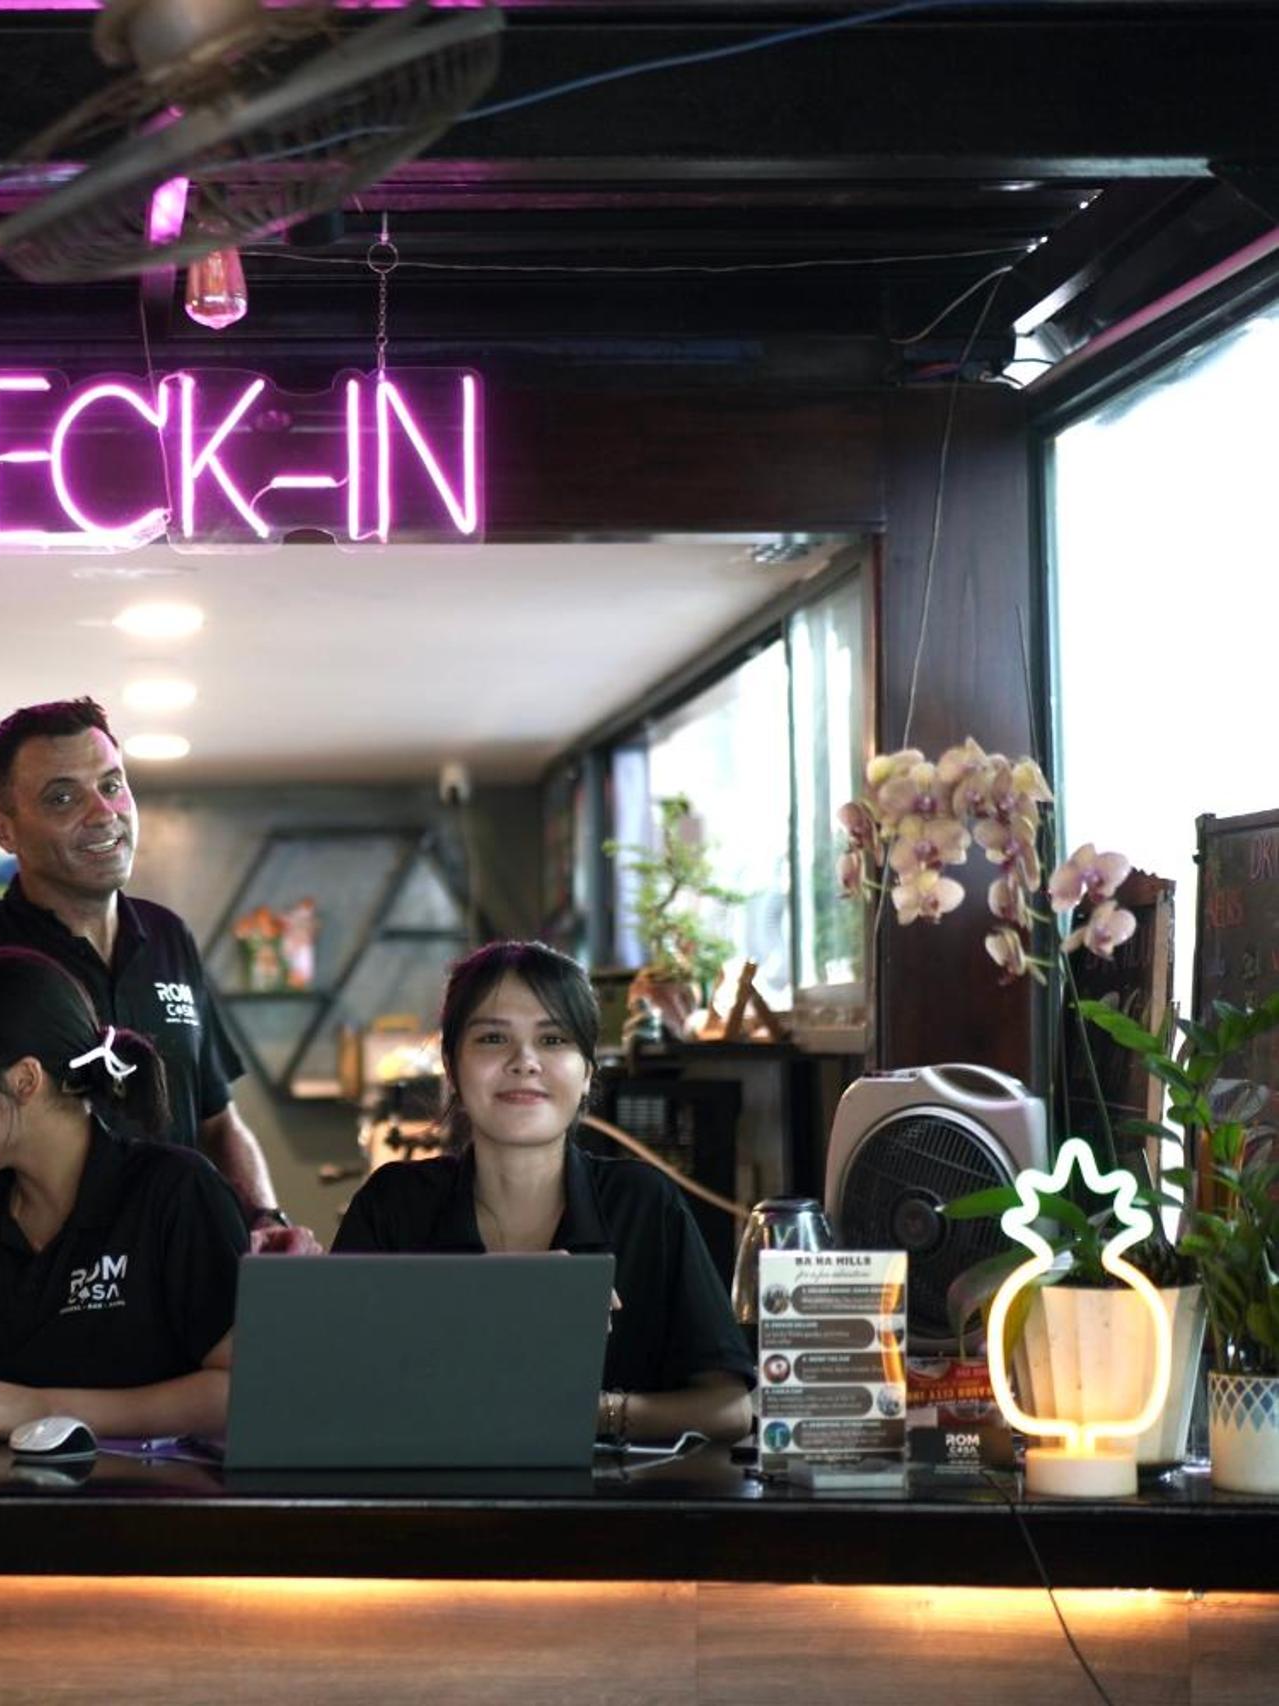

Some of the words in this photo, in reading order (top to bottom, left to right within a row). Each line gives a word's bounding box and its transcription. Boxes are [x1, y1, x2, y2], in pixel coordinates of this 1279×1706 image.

[153, 981, 195, 1005] ROM
[795, 1256, 812, 1266] BA
[836, 1256, 871, 1266] HILLS
[945, 1433, 980, 1447] ROM
